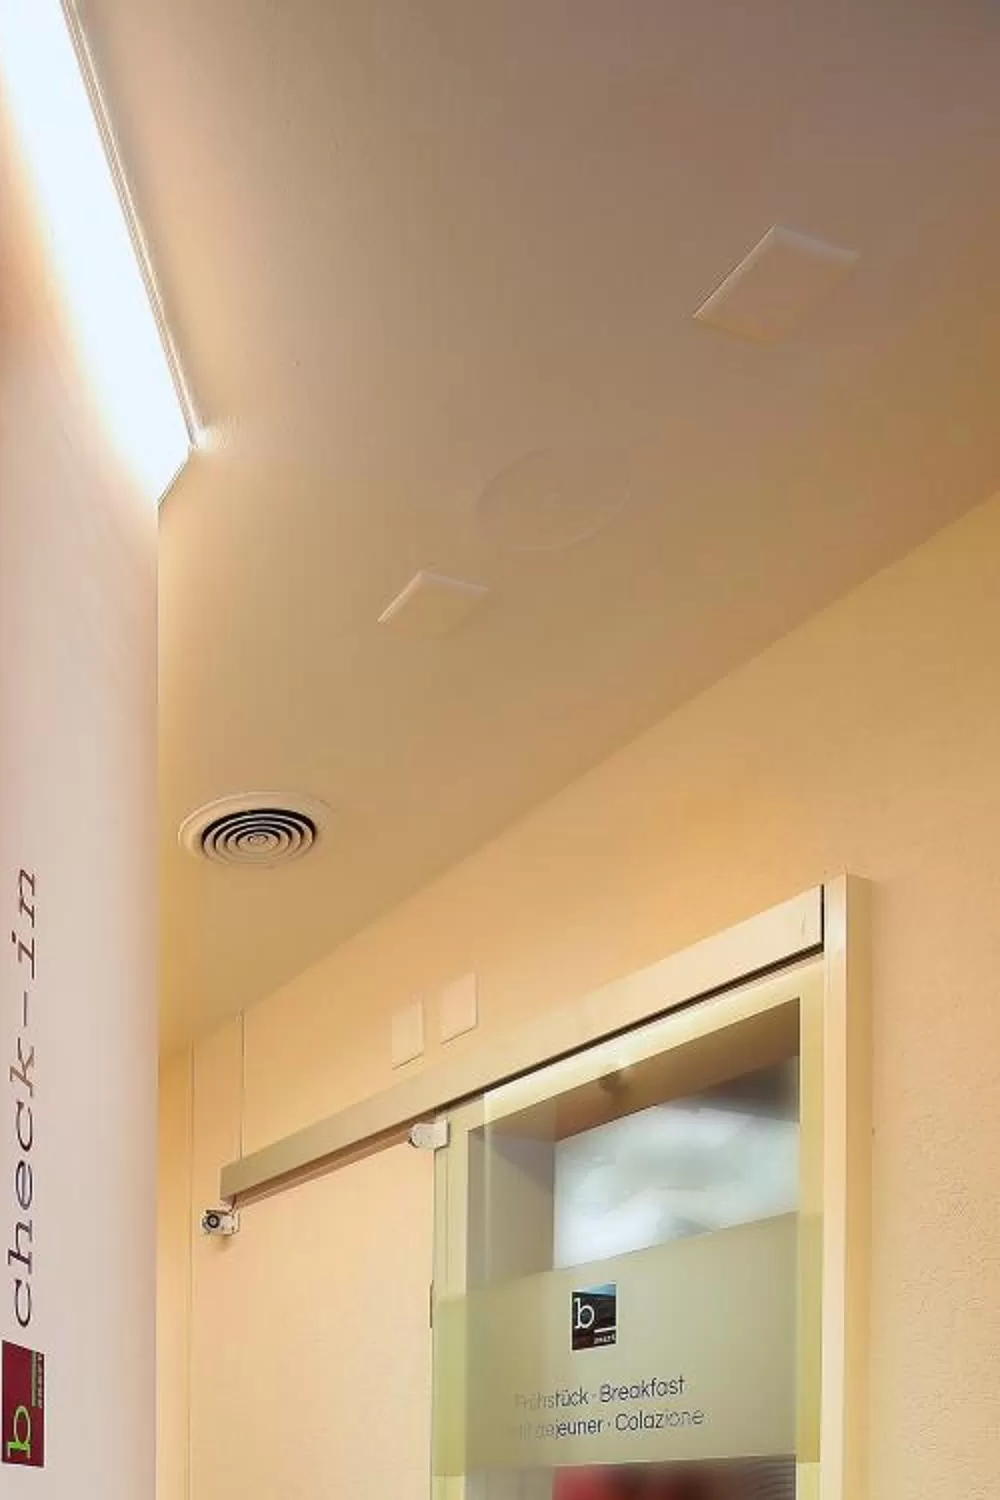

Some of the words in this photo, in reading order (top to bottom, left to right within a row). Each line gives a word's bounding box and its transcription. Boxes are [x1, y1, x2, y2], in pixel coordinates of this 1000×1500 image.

[7, 868, 36, 1329] check-in
[574, 1297, 596, 1329] b
[600, 1375, 686, 1403] Breakfast
[615, 1407, 705, 1432] Colazione
